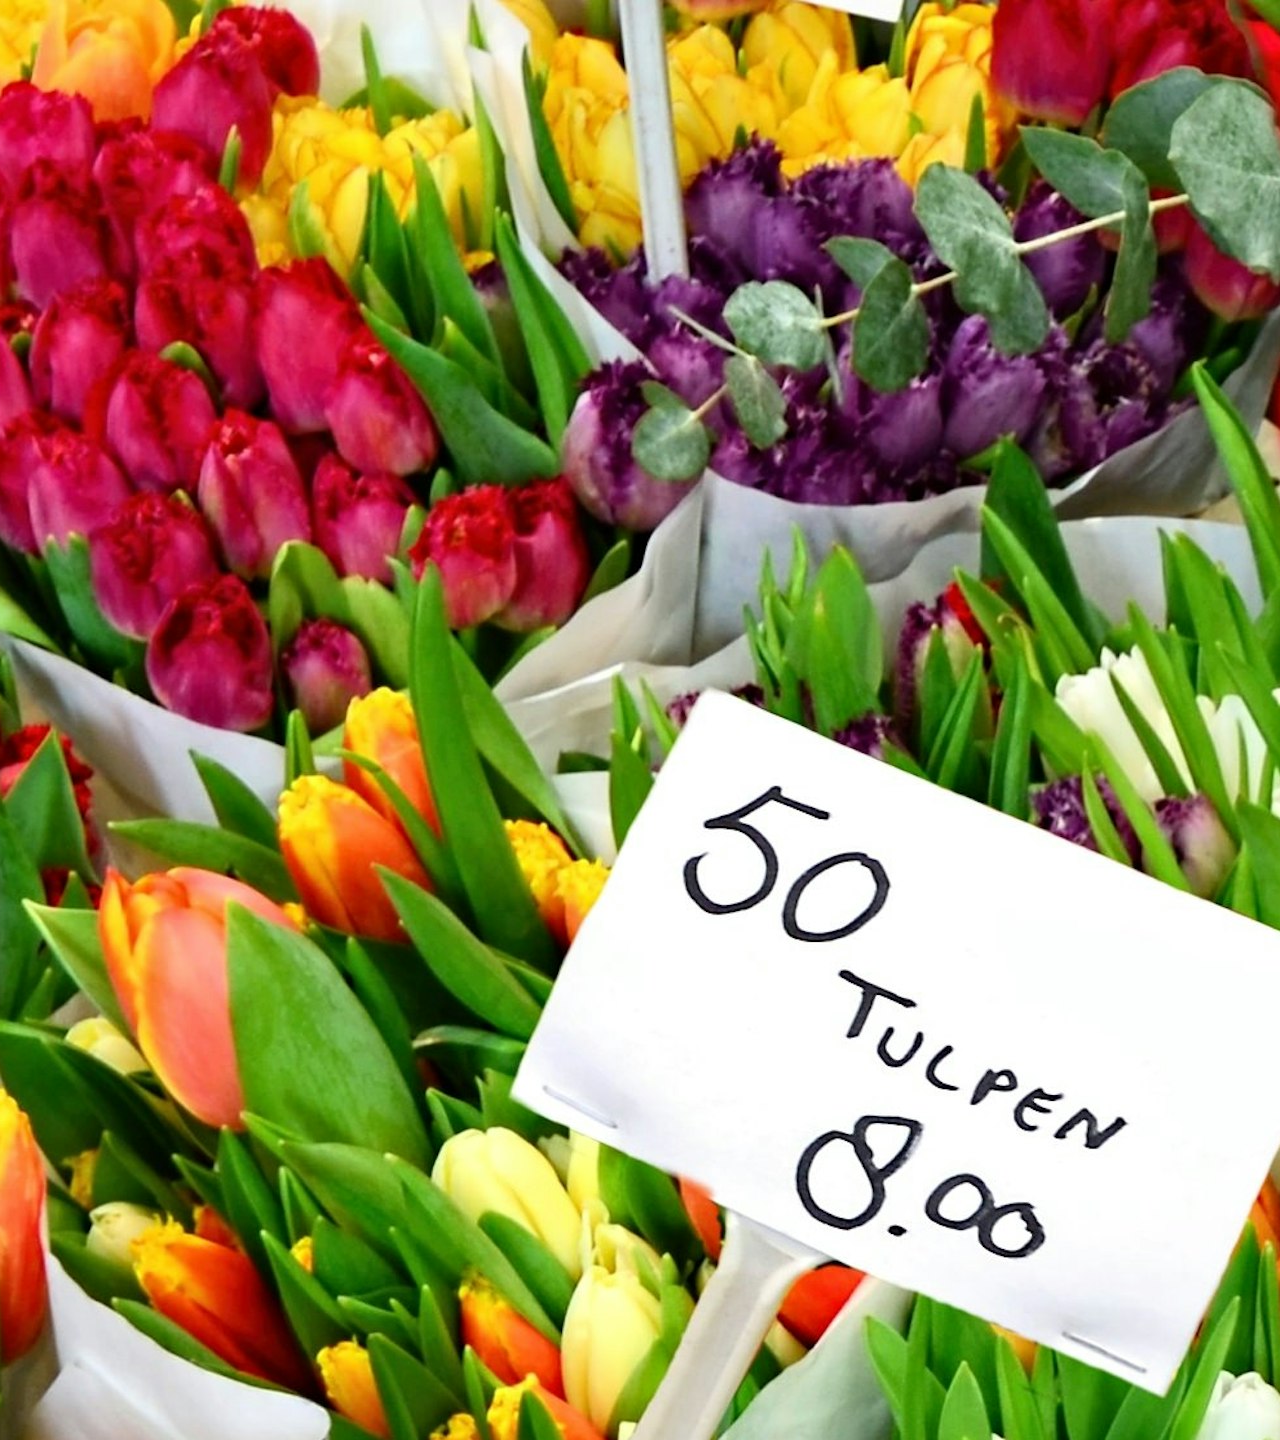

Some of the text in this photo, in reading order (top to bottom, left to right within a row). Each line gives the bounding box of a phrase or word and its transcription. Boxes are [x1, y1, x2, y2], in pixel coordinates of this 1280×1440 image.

[683, 785, 891, 943] 50
[838, 969, 1128, 1150] TULPEN
[795, 1115, 1046, 1259] 8.00
